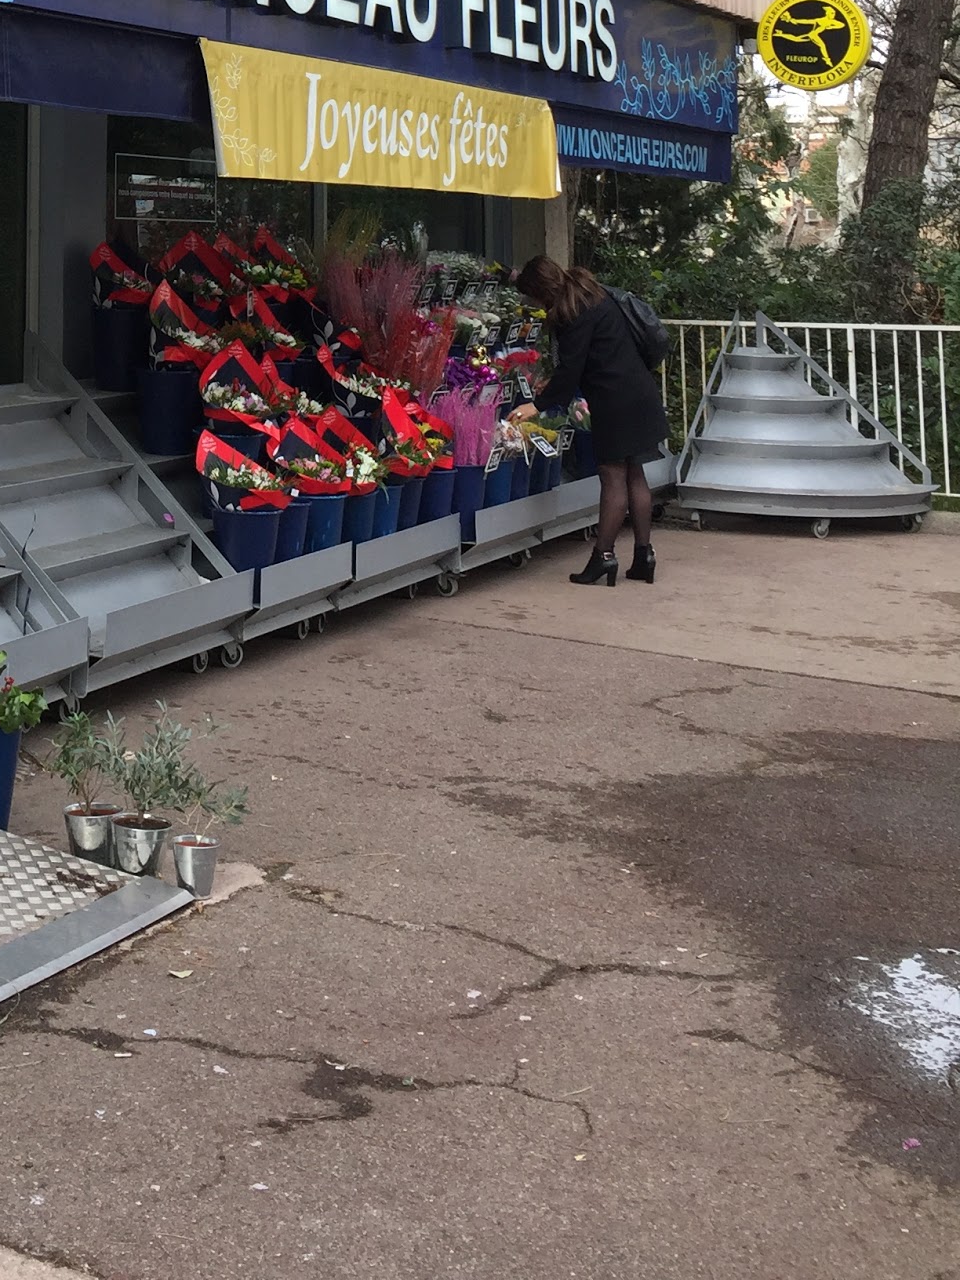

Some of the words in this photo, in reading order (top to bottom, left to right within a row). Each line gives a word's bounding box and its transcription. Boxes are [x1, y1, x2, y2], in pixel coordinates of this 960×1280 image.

[766, 0, 790, 24] FLEURS
[851, 17, 861, 47] ENTIER
[768, 57, 853, 86] INTERFLORA
[786, 55, 818, 64] FLEUROP
[299, 72, 440, 179] Joyeuses
[442, 90, 509, 186] fêtes
